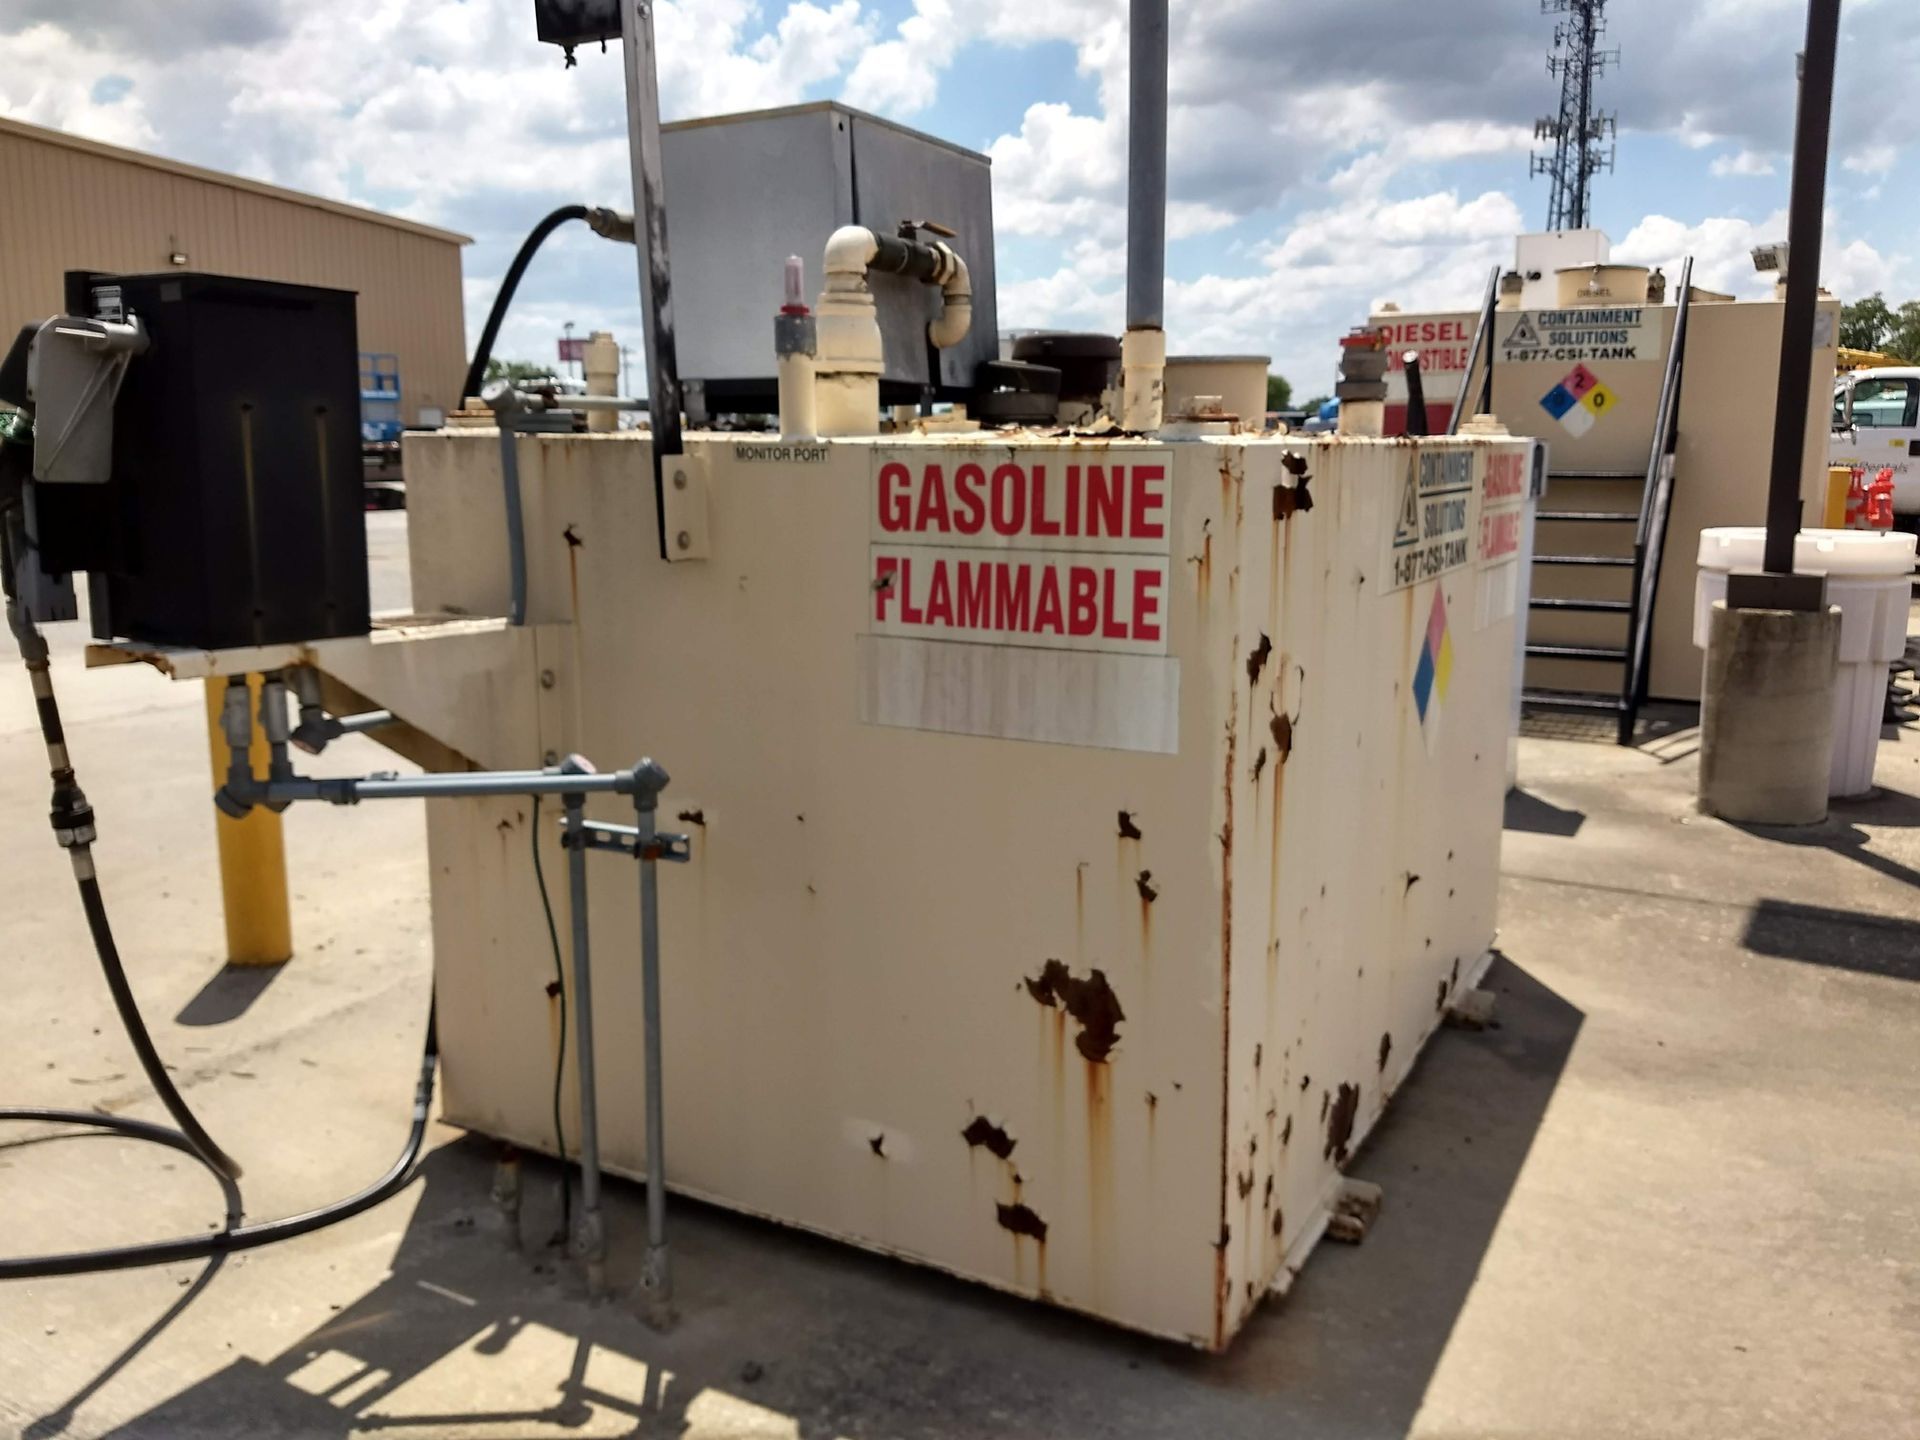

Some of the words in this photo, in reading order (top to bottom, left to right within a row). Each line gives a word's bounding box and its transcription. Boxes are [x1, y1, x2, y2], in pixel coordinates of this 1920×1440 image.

[1538, 309, 1643, 326] CONTAINMENT
[1380, 321, 1469, 345] DIESEL
[1549, 330, 1628, 346] SOLUTIONS
[1505, 348, 1637, 361] 1-877-CSI-TANK
[1575, 373, 1585, 389] 2
[1593, 392, 1605, 408] 0
[736, 447, 791, 460] MONITOR
[794, 448, 828, 461] PORT
[878, 462, 1165, 538] GASOLINE
[1394, 537, 1468, 586] 1-877-CSI-TANK
[875, 557, 1162, 641] FLAMMABLE
